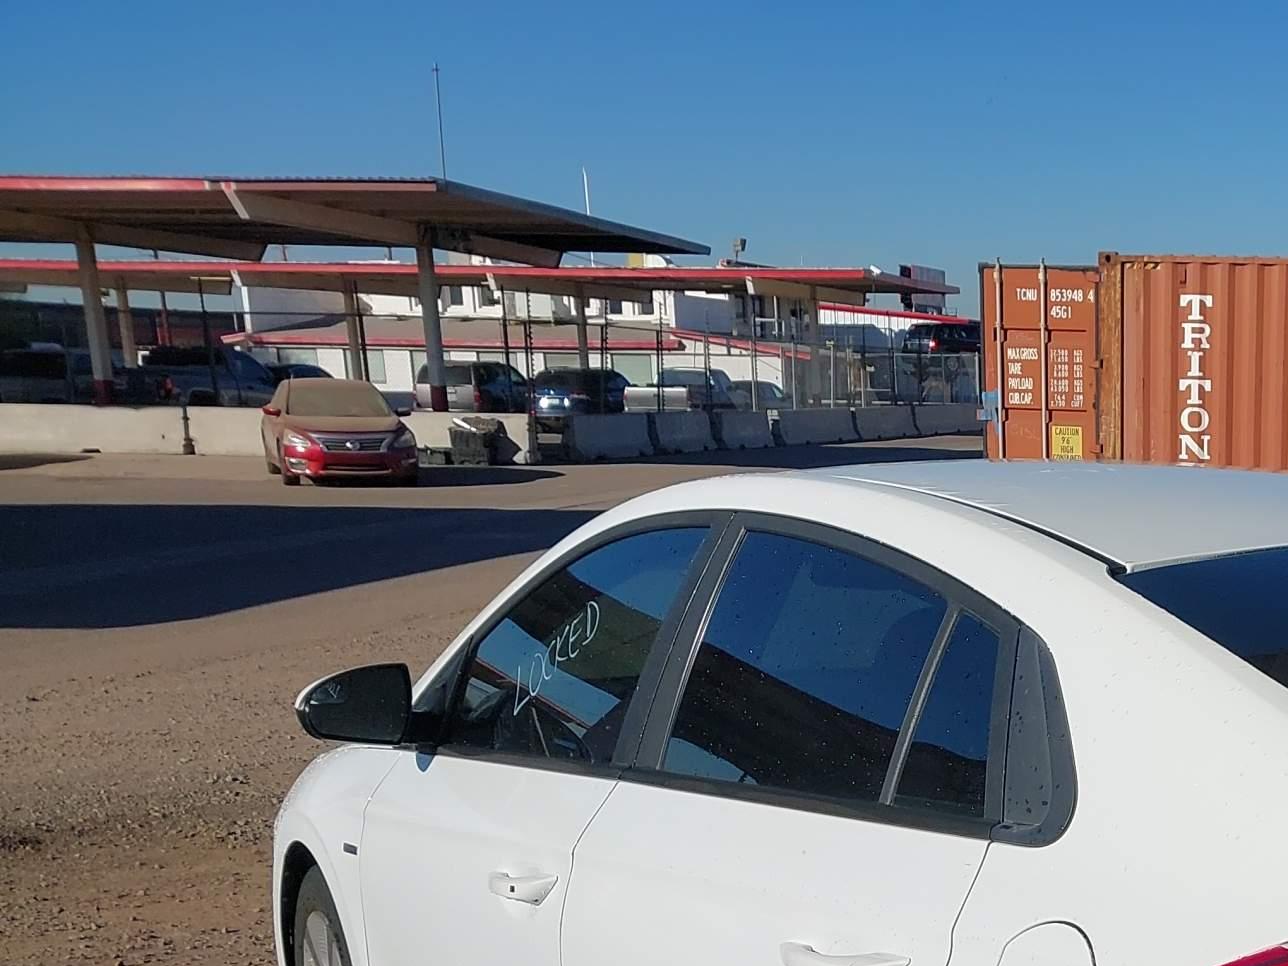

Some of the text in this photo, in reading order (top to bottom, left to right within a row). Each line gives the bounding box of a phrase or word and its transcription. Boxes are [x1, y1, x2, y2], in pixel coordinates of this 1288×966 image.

[1016, 288, 1095, 302] TCNU 853948 4
[1008, 348, 1020, 360] MAX
[1020, 348, 1039, 360] GROSS
[1008, 363, 1022, 375] TARE
[1008, 378, 1033, 389] PAYLOAD
[1179, 295, 1213, 460] TRITON
[1054, 427, 1080, 436] CAUTION
[1060, 445, 1074, 454] HIGH
[513, 600, 600, 716] LOCKED
